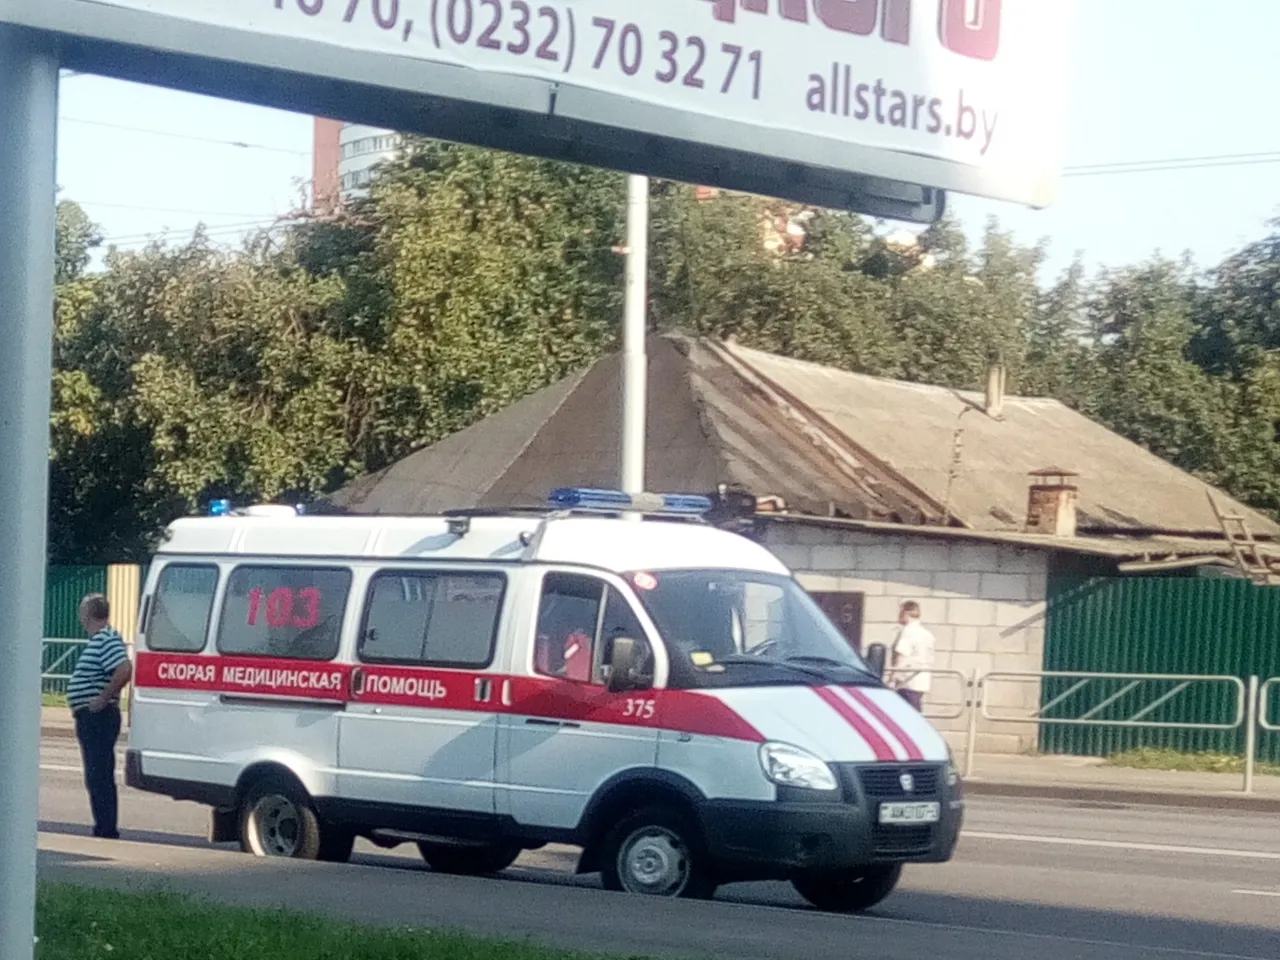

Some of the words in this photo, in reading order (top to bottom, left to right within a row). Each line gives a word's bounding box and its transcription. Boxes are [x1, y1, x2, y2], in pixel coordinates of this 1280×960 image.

[431, 0, 575, 73] (0232)
[592, 16, 642, 76] 70
[655, 30, 706, 89] 32
[720, 42, 762, 100] 71
[806, 61, 997, 156] allstars.by
[246, 587, 321, 628] 103
[158, 663, 216, 681] СКОРАЯ
[222, 666, 342, 690] МЕДИЦИНСКАЯ
[366, 674, 447, 700] ПОМОЩЬ
[622, 698, 656, 718] 375
